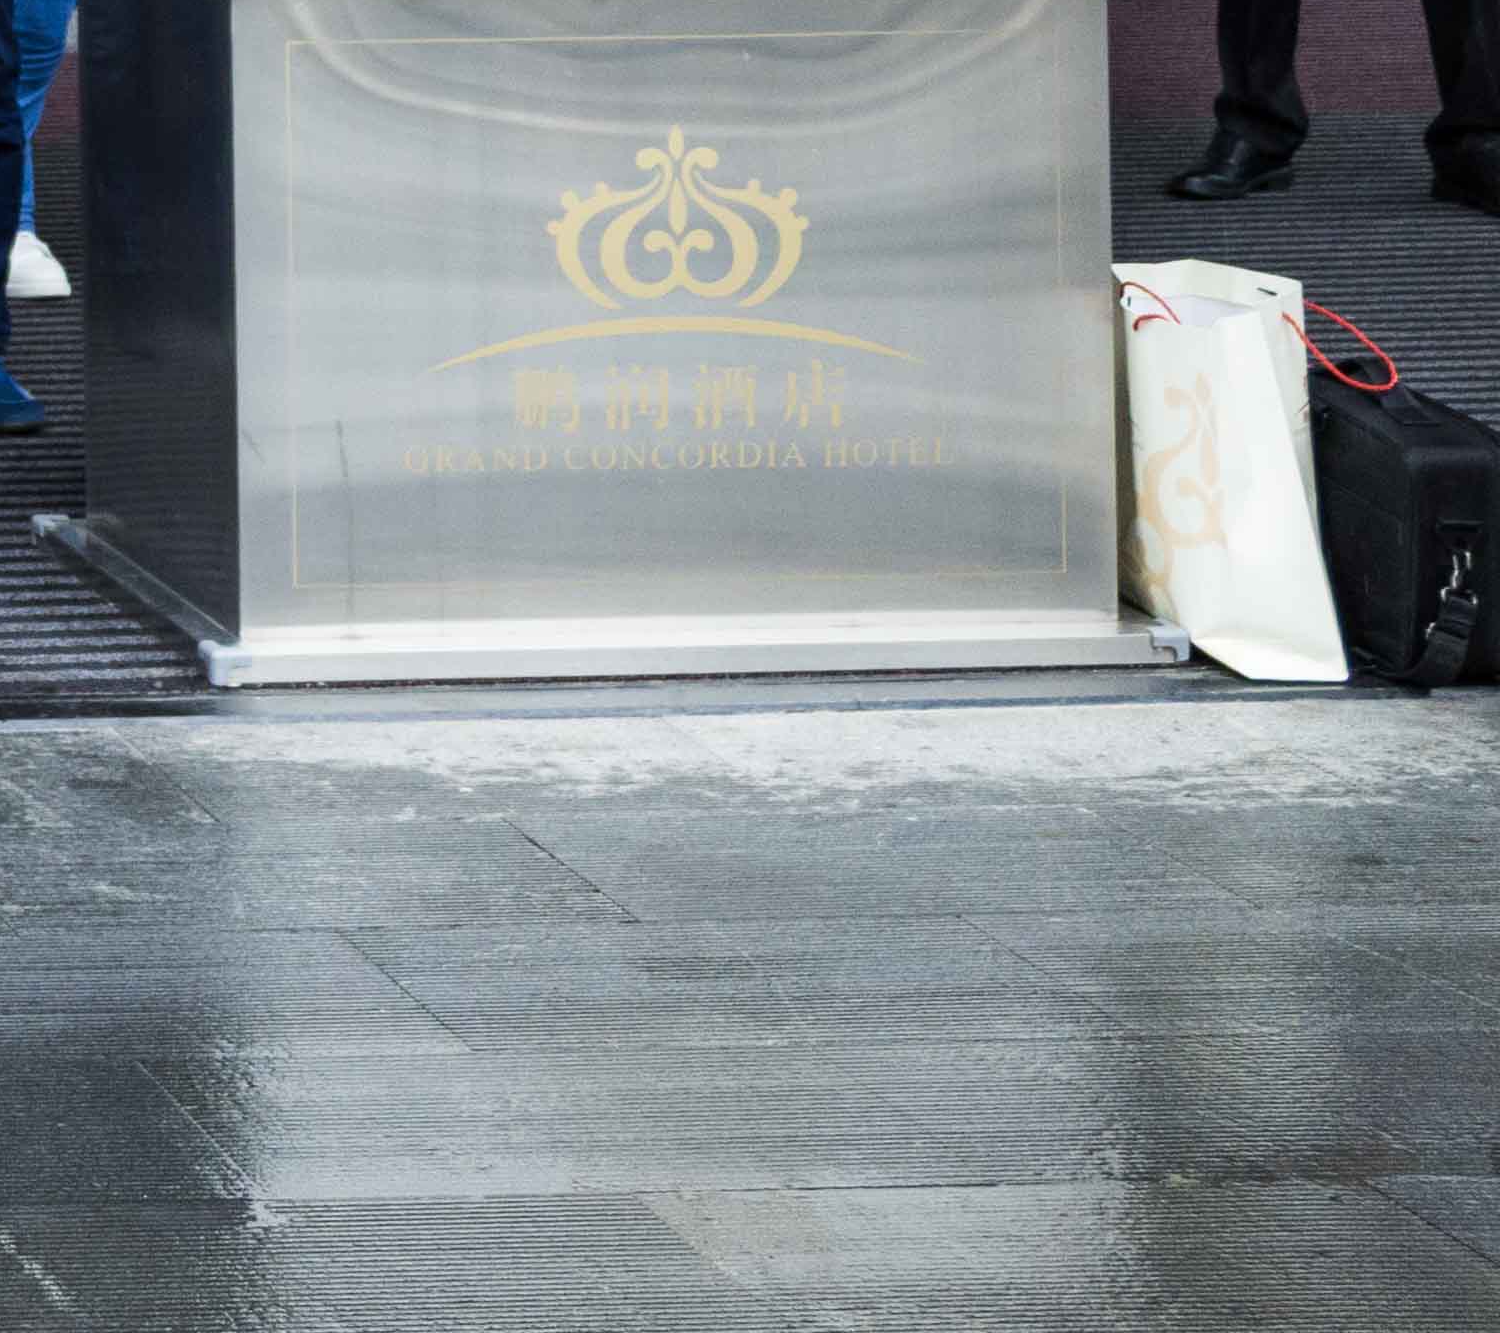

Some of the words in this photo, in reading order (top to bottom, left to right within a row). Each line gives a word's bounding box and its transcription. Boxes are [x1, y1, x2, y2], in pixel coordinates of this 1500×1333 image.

[403, 445, 549, 476] GRAND
[564, 436, 807, 472] CONCORDIA
[823, 435, 953, 469] HOTEL
